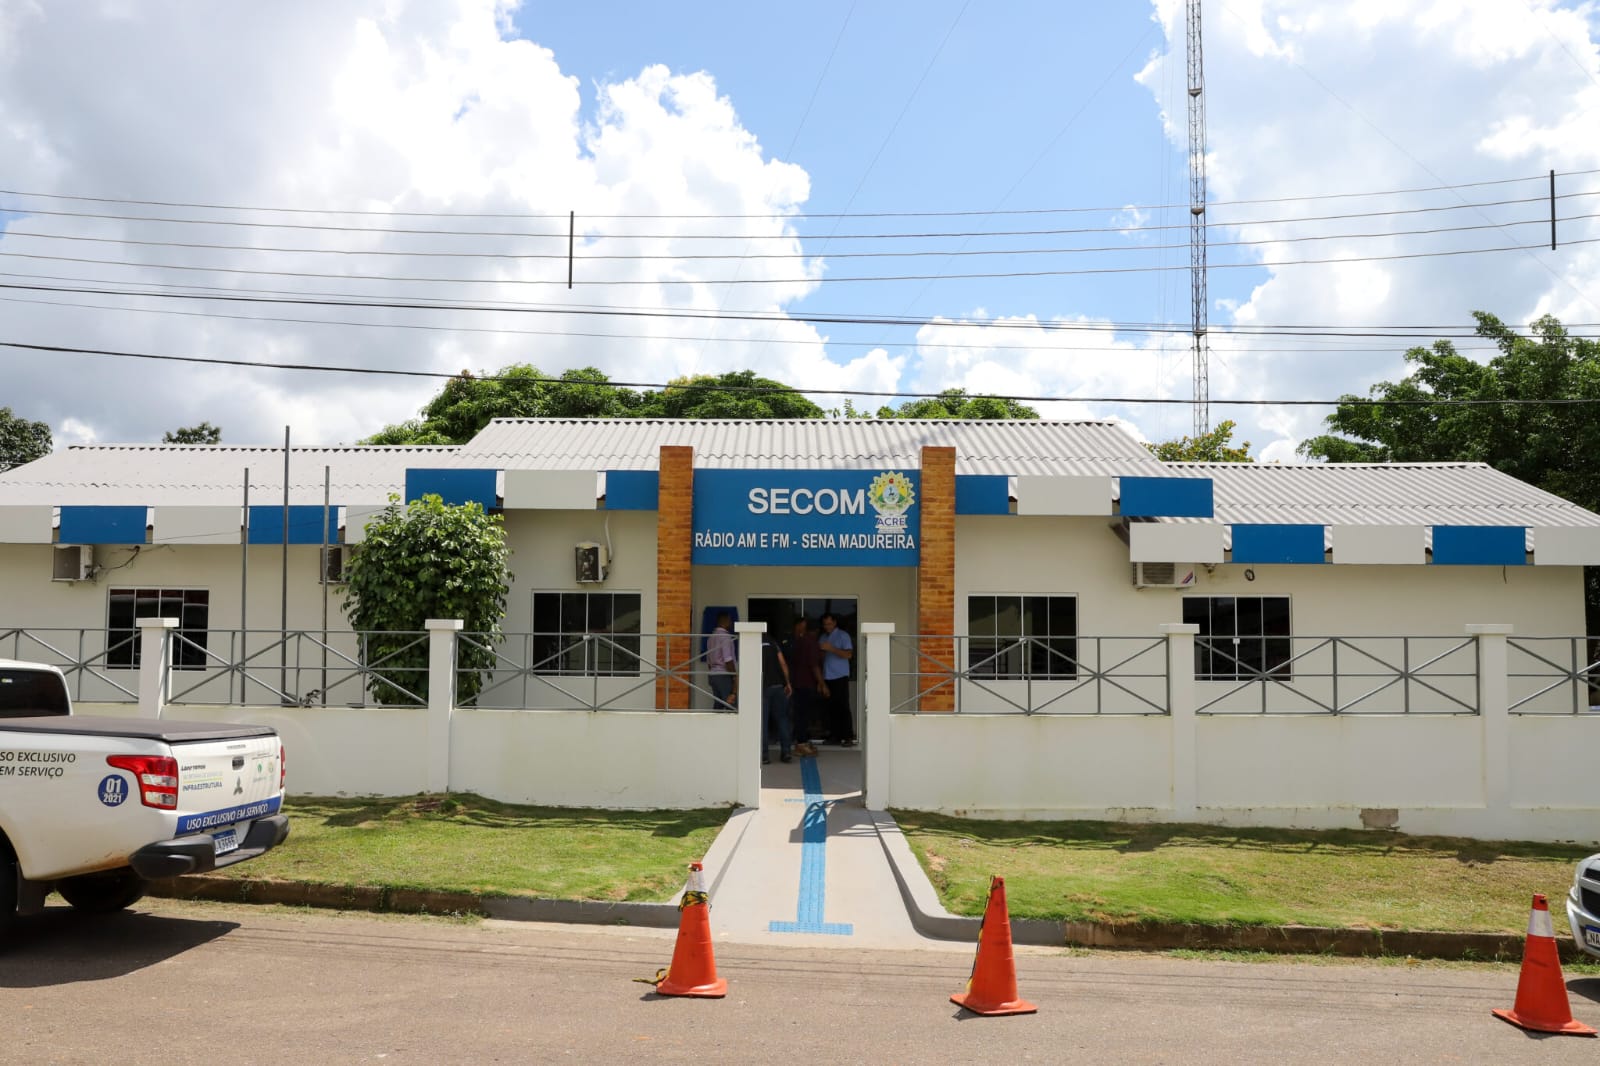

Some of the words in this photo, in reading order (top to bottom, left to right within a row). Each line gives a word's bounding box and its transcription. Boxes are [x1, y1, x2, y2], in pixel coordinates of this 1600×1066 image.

[748, 487, 865, 515] SECOM
[877, 517, 905, 526] ACRE
[695, 529, 735, 548] RÁDIO
[738, 533, 757, 548] AM
[760, 533, 768, 548] E
[772, 533, 790, 548] FM
[801, 533, 835, 549] SENA
[839, 533, 915, 549] MADUREIRA
[18, 752, 76, 763] EXCLUSIVO
[0, 766, 15, 776] EM
[18, 766, 64, 779] SERVIÇO
[105, 778, 122, 793] 01
[103, 792, 122, 803] 2021
[186, 818, 202, 830] USO
[202, 811, 236, 828] EXCLUSIVO
[236, 808, 246, 820] EM
[245, 803, 269, 818] SERVIÇO
